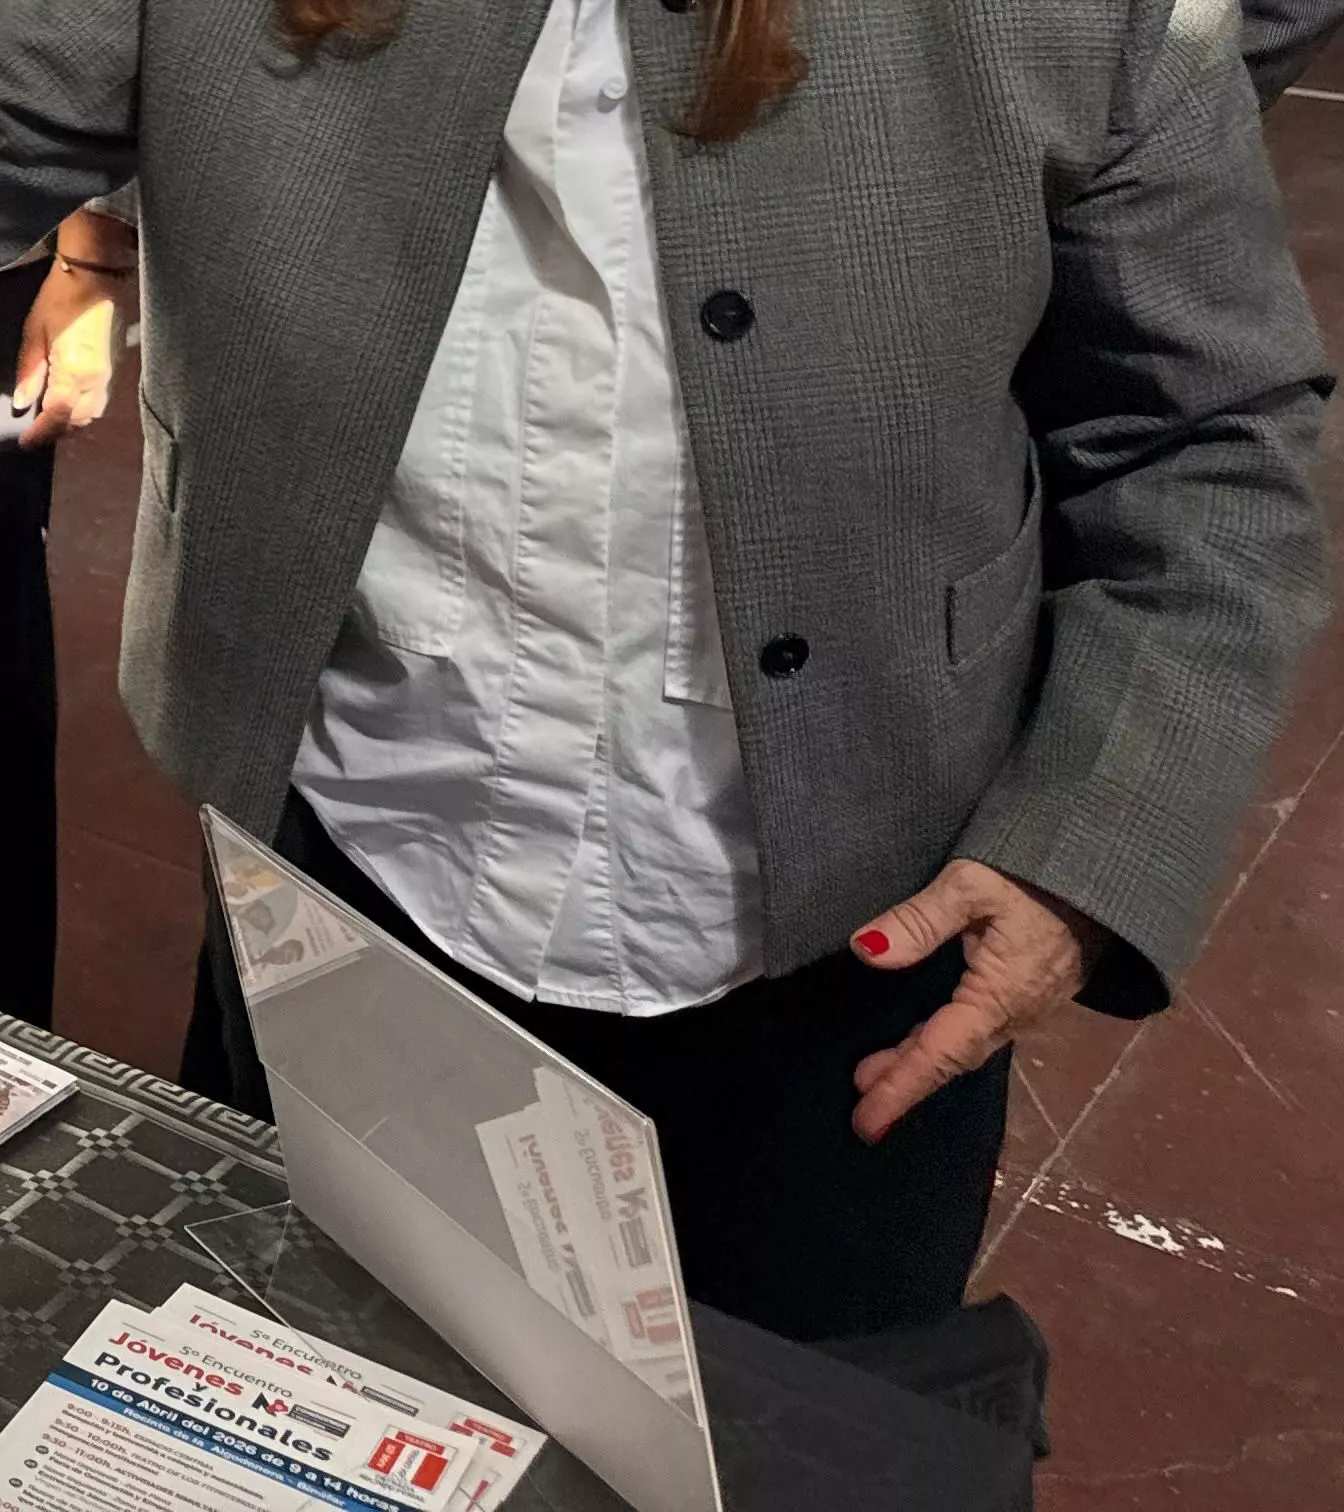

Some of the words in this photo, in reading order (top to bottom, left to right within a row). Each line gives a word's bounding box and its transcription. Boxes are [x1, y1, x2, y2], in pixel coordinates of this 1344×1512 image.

[110, 1333, 248, 1394] Jóvenes
[178, 1345, 200, 1356] 5º
[202, 1354, 292, 1397] Encuentro
[272, 1337, 363, 1381] Encuentro
[96, 1353, 329, 1459] Profesionales
[191, 1381, 208, 1392] y
[91, 1378, 109, 1391] 10
[111, 1389, 133, 1402] de
[136, 1399, 178, 1421] Abril
[181, 1419, 209, 1435] del
[212, 1431, 256, 1454] 2026
[260, 1453, 284, 1466] de
[288, 1462, 301, 1473] 9
[304, 1471, 317, 1481] a
[323, 1477, 341, 1490] 14
[346, 1486, 398, 1512] horas
[119, 1407, 170, 1432] Recinto
[172, 1429, 189, 1440] de
